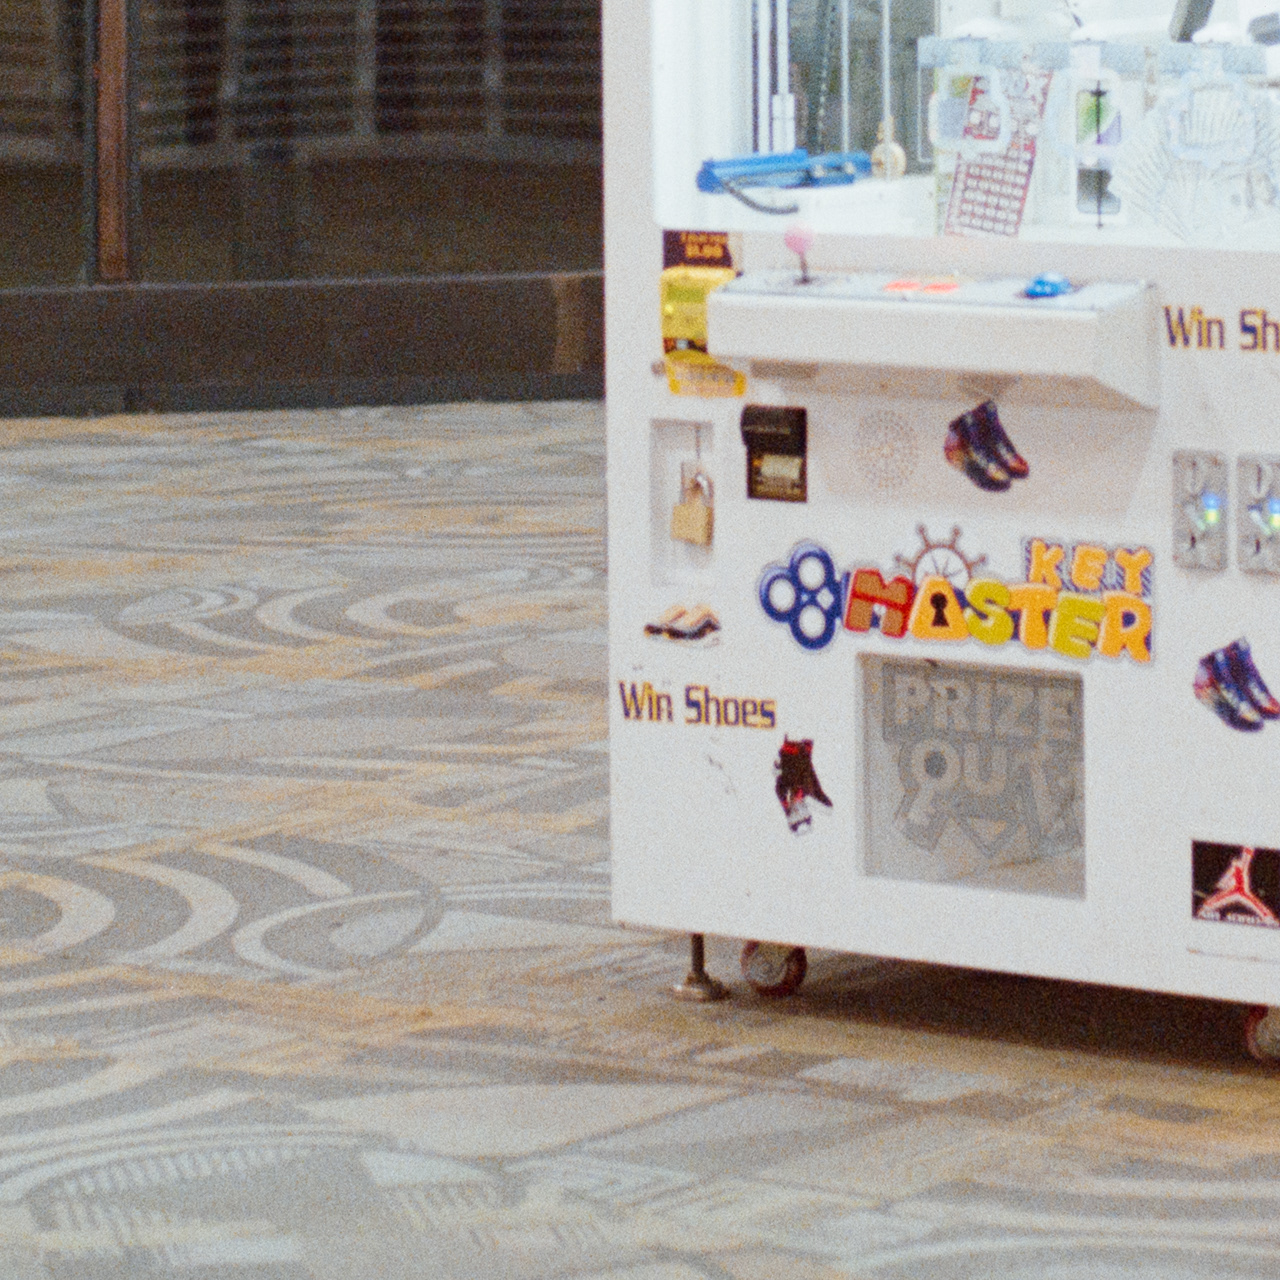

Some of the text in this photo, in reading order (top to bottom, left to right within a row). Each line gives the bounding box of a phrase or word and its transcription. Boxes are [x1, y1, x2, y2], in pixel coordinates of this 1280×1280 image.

[1162, 303, 1226, 351] Win
[1026, 537, 1153, 595] KEY
[843, 568, 1154, 663] MASTER
[617, 680, 778, 731] Win Shoes
[893, 673, 1076, 742] PRIZE
[910, 736, 1061, 833] OUT
